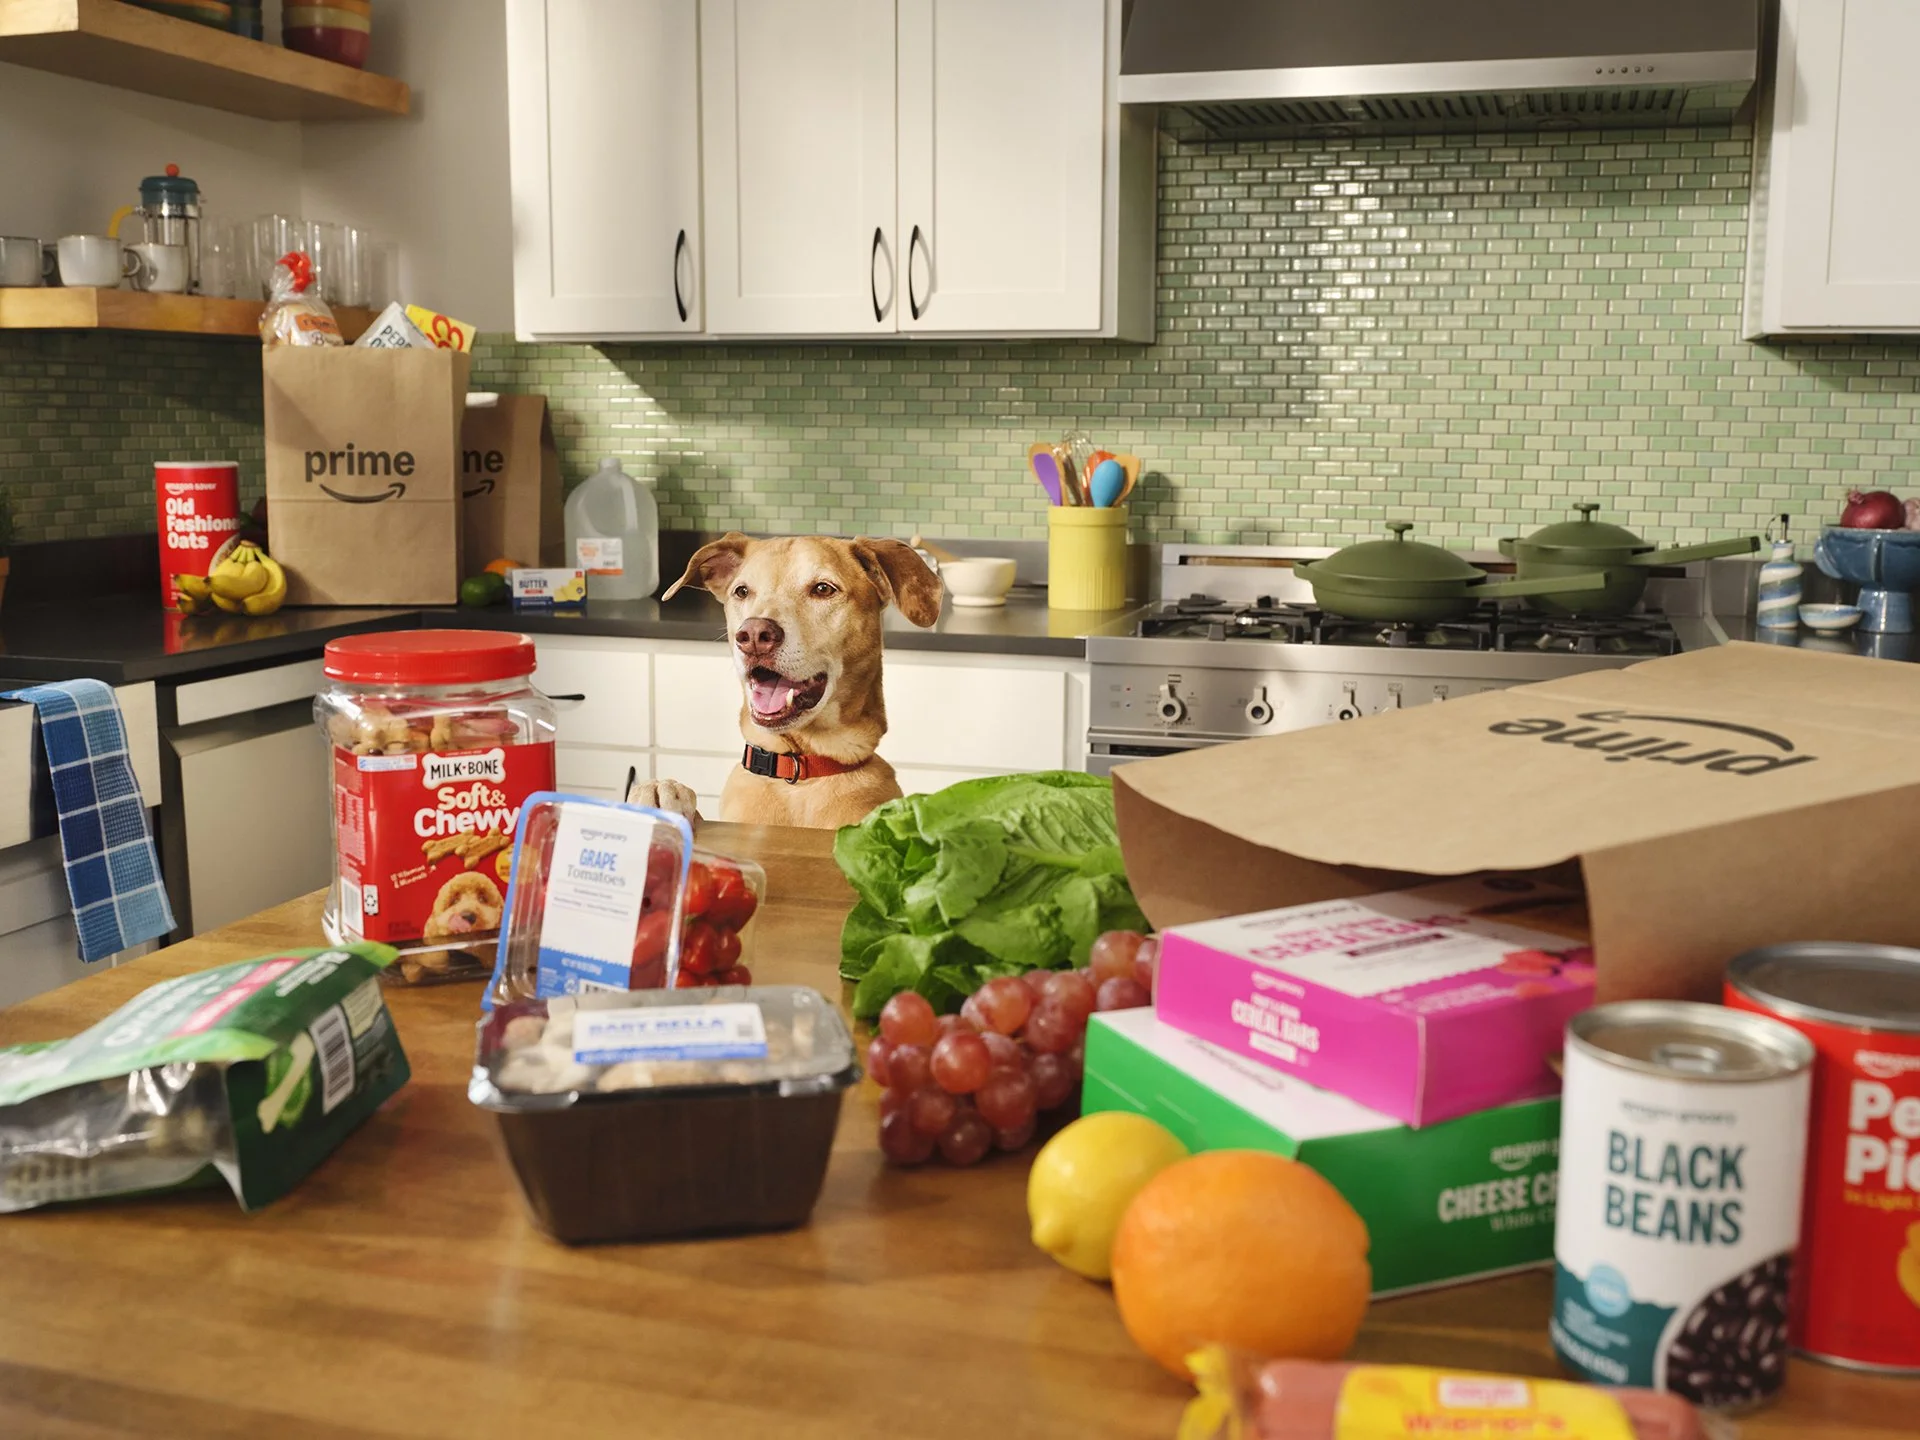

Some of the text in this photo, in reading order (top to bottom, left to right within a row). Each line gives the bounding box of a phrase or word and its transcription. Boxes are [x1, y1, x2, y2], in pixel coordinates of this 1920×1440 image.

[305, 443, 415, 482] prime
[165, 498, 195, 515] Old
[167, 532, 209, 549] Oats
[519, 579, 548, 589] BUTTER
[1488, 718, 1818, 776] prime
[414, 806, 521, 837] Chewy
[579, 847, 618, 872] GRAPE
[567, 864, 627, 887] Tomatoes
[1608, 1129, 1746, 1191] BLACK
[1438, 1175, 1530, 1223] CHEESE
[1606, 1184, 1742, 1244] BEANS
